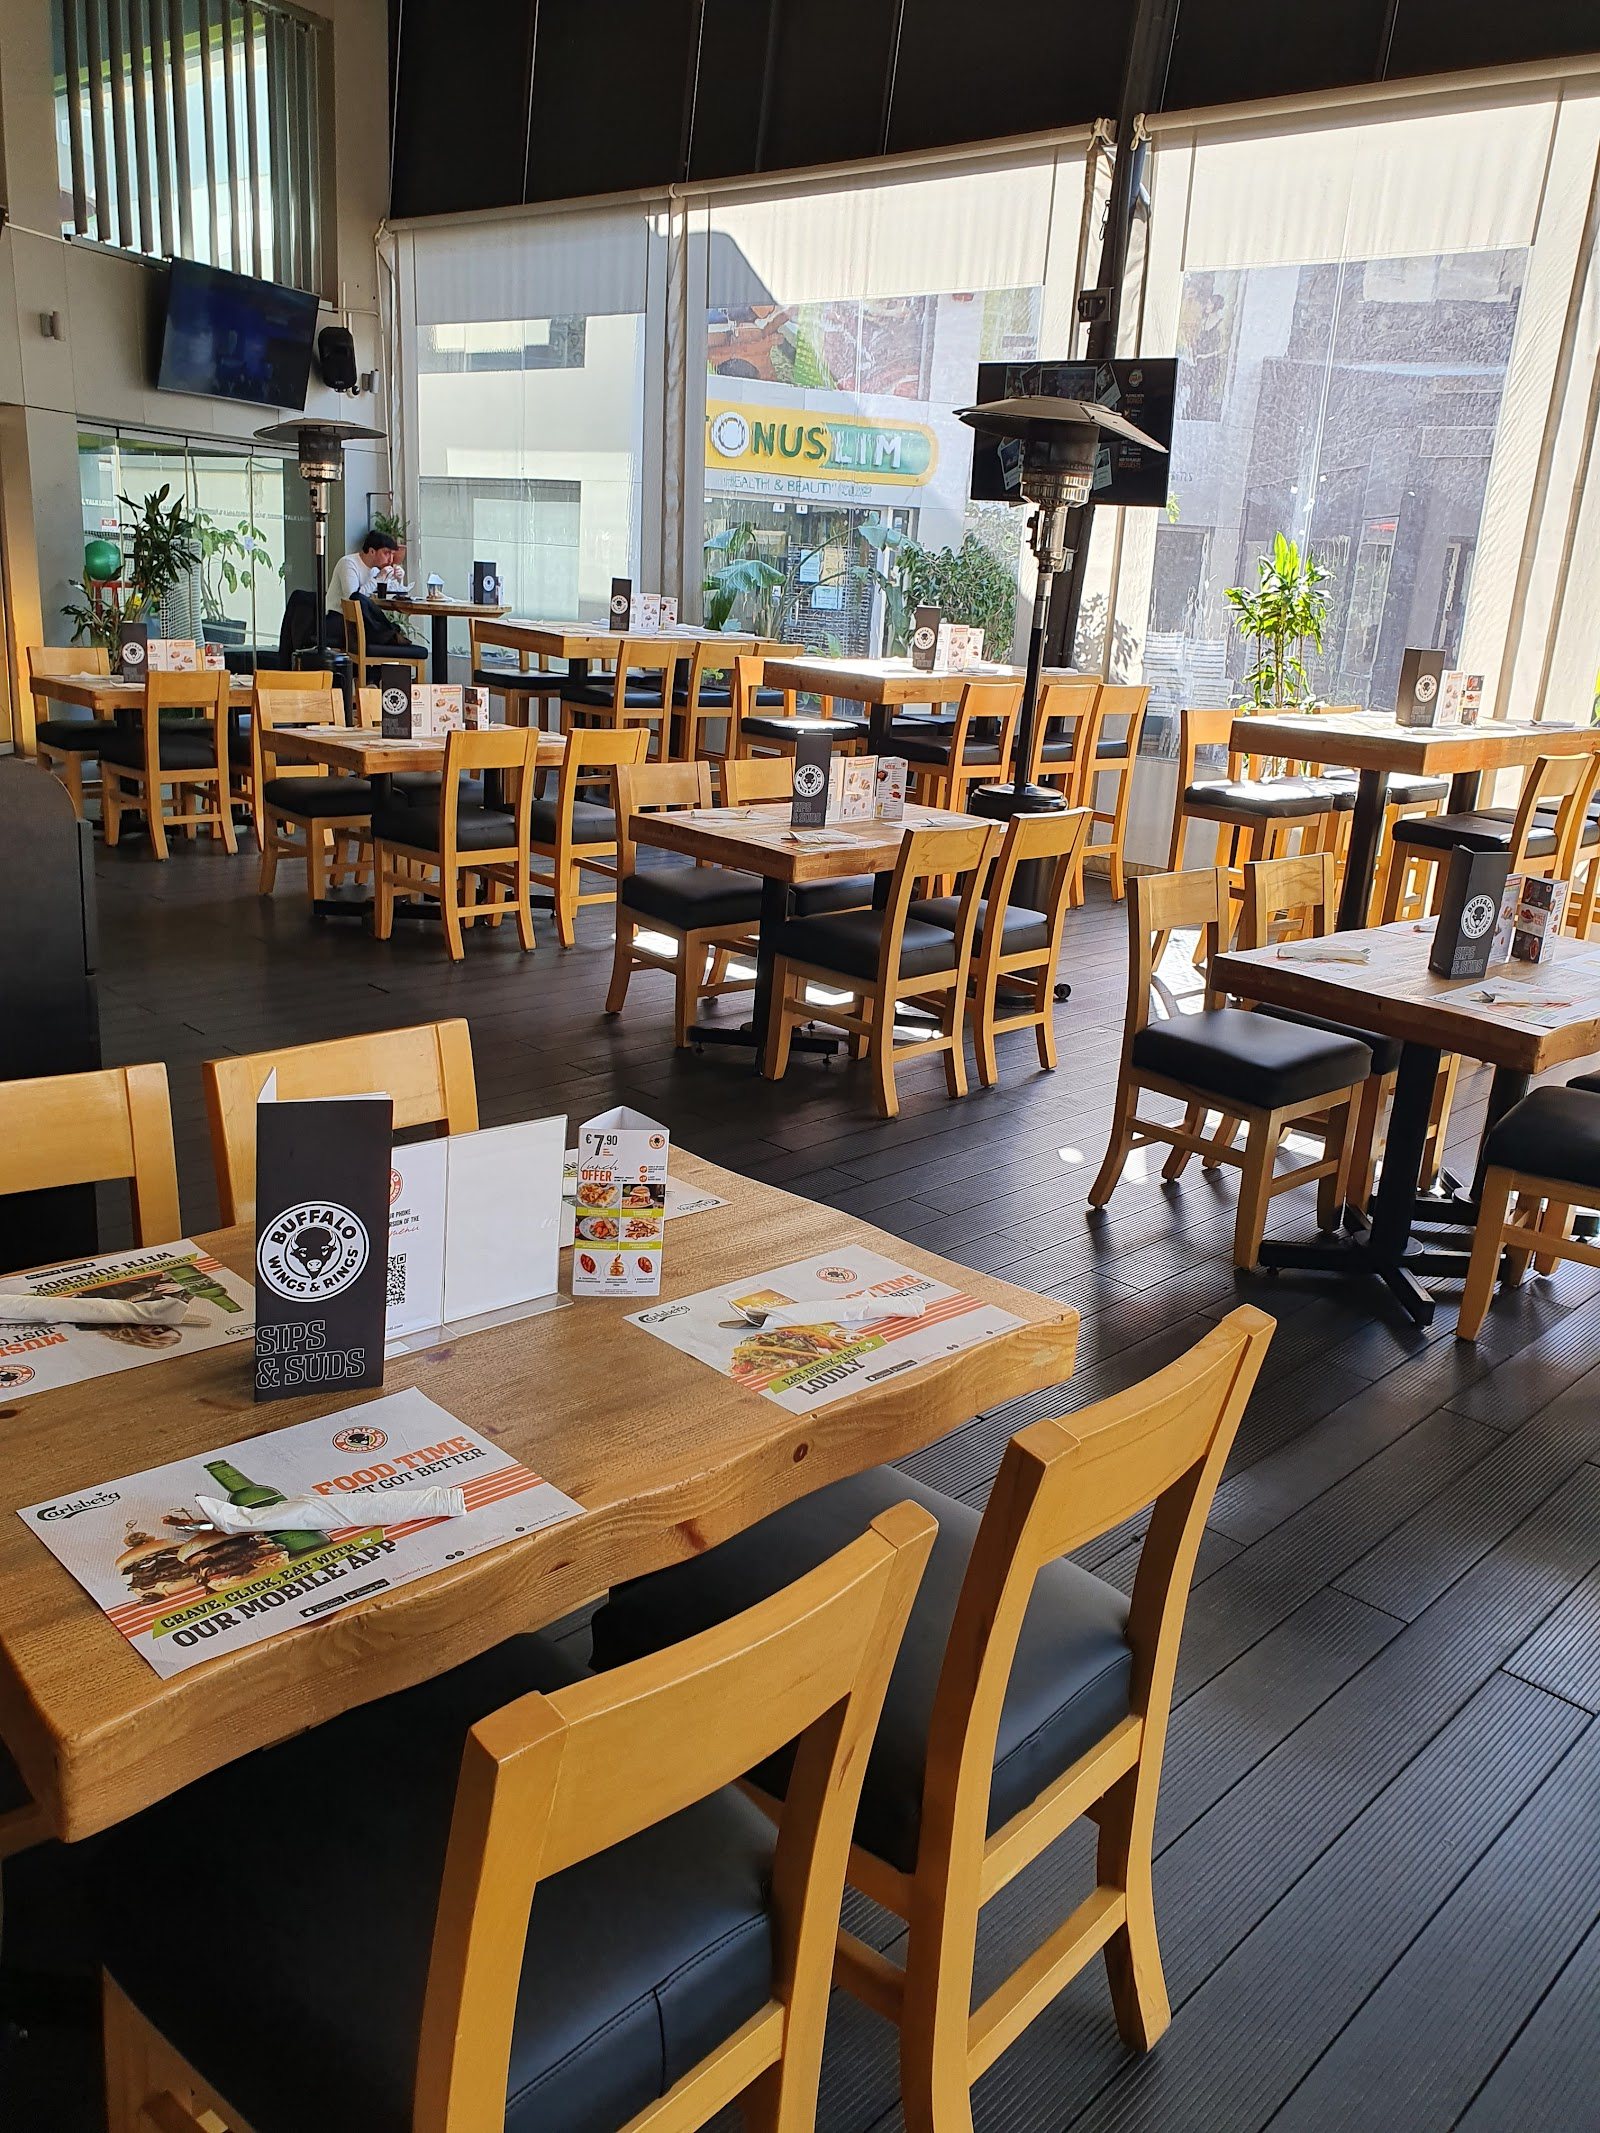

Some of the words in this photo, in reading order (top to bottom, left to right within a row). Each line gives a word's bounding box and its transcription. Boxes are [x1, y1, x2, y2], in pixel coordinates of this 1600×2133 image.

[706, 411, 902, 468] ONUSLIM
[722, 476, 769, 491] HEALTH
[774, 478, 784, 490] &
[798, 767, 821, 778] BUFFALO
[1467, 898, 1492, 913] BUFFALO
[585, 1133, 618, 1156] €7.90
[582, 1169, 612, 1181] OFFER
[270, 1208, 357, 1246] BUFFALO
[121, 1251, 176, 1269] WITH
[146, 1255, 192, 1272] CHOOSE
[267, 1258, 307, 1292] WINGS
[309, 1280, 321, 1292] &
[323, 1247, 360, 1290] RINGS
[30, 1265, 120, 1293] JUKEBOX
[71, 1276, 103, 1289] YOUR
[105, 1270, 137, 1281] PLAY
[638, 1305, 691, 1323] Carlsberg
[13, 1327, 57, 1343] JUST
[256, 1319, 327, 1357] SIPS
[255, 1358, 281, 1389] &
[283, 1347, 366, 1384] SUDS
[782, 1373, 810, 1386] EAT,
[836, 1346, 866, 1361] TALK
[796, 1357, 866, 1395] LOUDLY
[311, 1463, 398, 1495] FOOD
[391, 1435, 476, 1469] TIME
[378, 1471, 414, 1489] GOT
[414, 1447, 487, 1477] BETTER
[37, 1491, 121, 1521] Carlsberg
[160, 1599, 228, 1629] CRAVE,
[224, 1577, 282, 1603] CLICK,
[278, 1561, 313, 1580] EAT
[315, 1543, 359, 1569] WITH
[171, 1608, 242, 1647] OUR
[234, 1563, 349, 1619] MOBILE
[345, 1539, 397, 1571] APP
